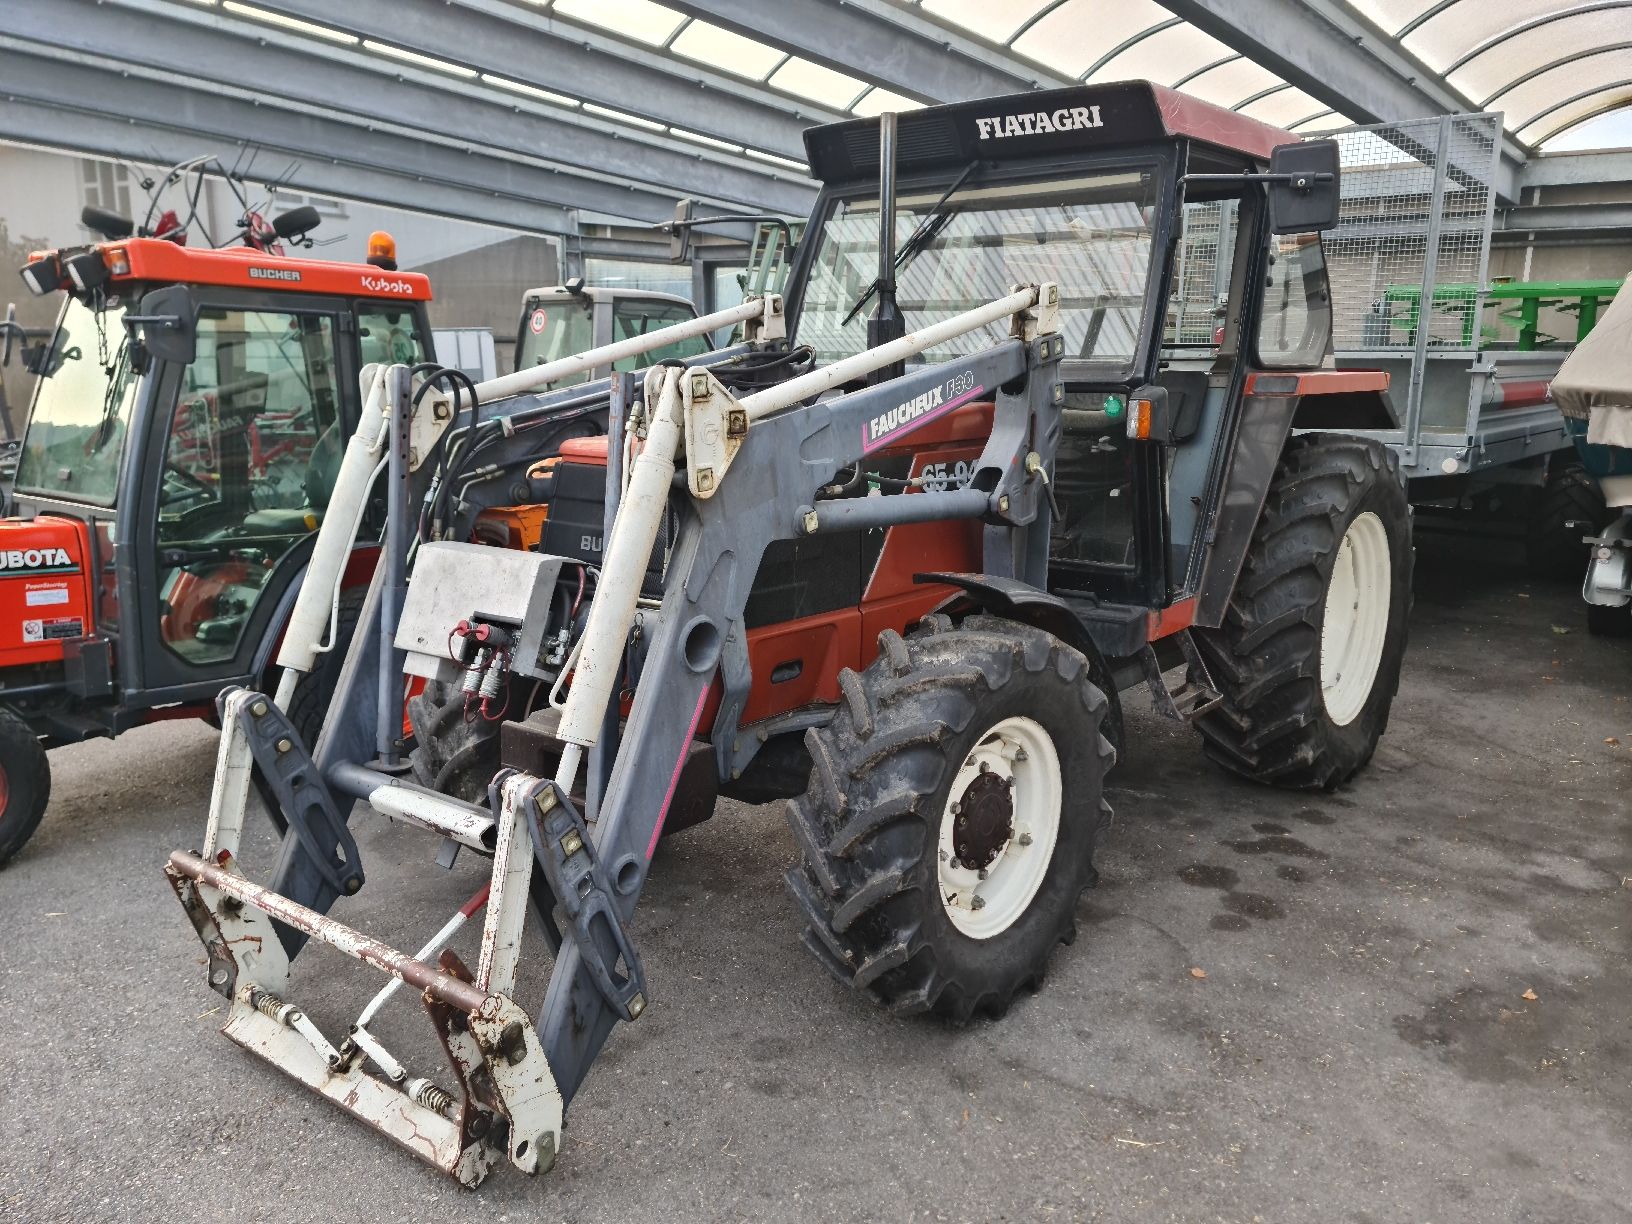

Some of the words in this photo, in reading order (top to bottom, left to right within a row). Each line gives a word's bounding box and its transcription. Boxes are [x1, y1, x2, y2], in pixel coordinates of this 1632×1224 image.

[976, 105, 1103, 139] FIATAGRI
[250, 268, 300, 280] BUCHER
[361, 276, 413, 294] Kubota
[870, 385, 943, 439] FAUCHEUX
